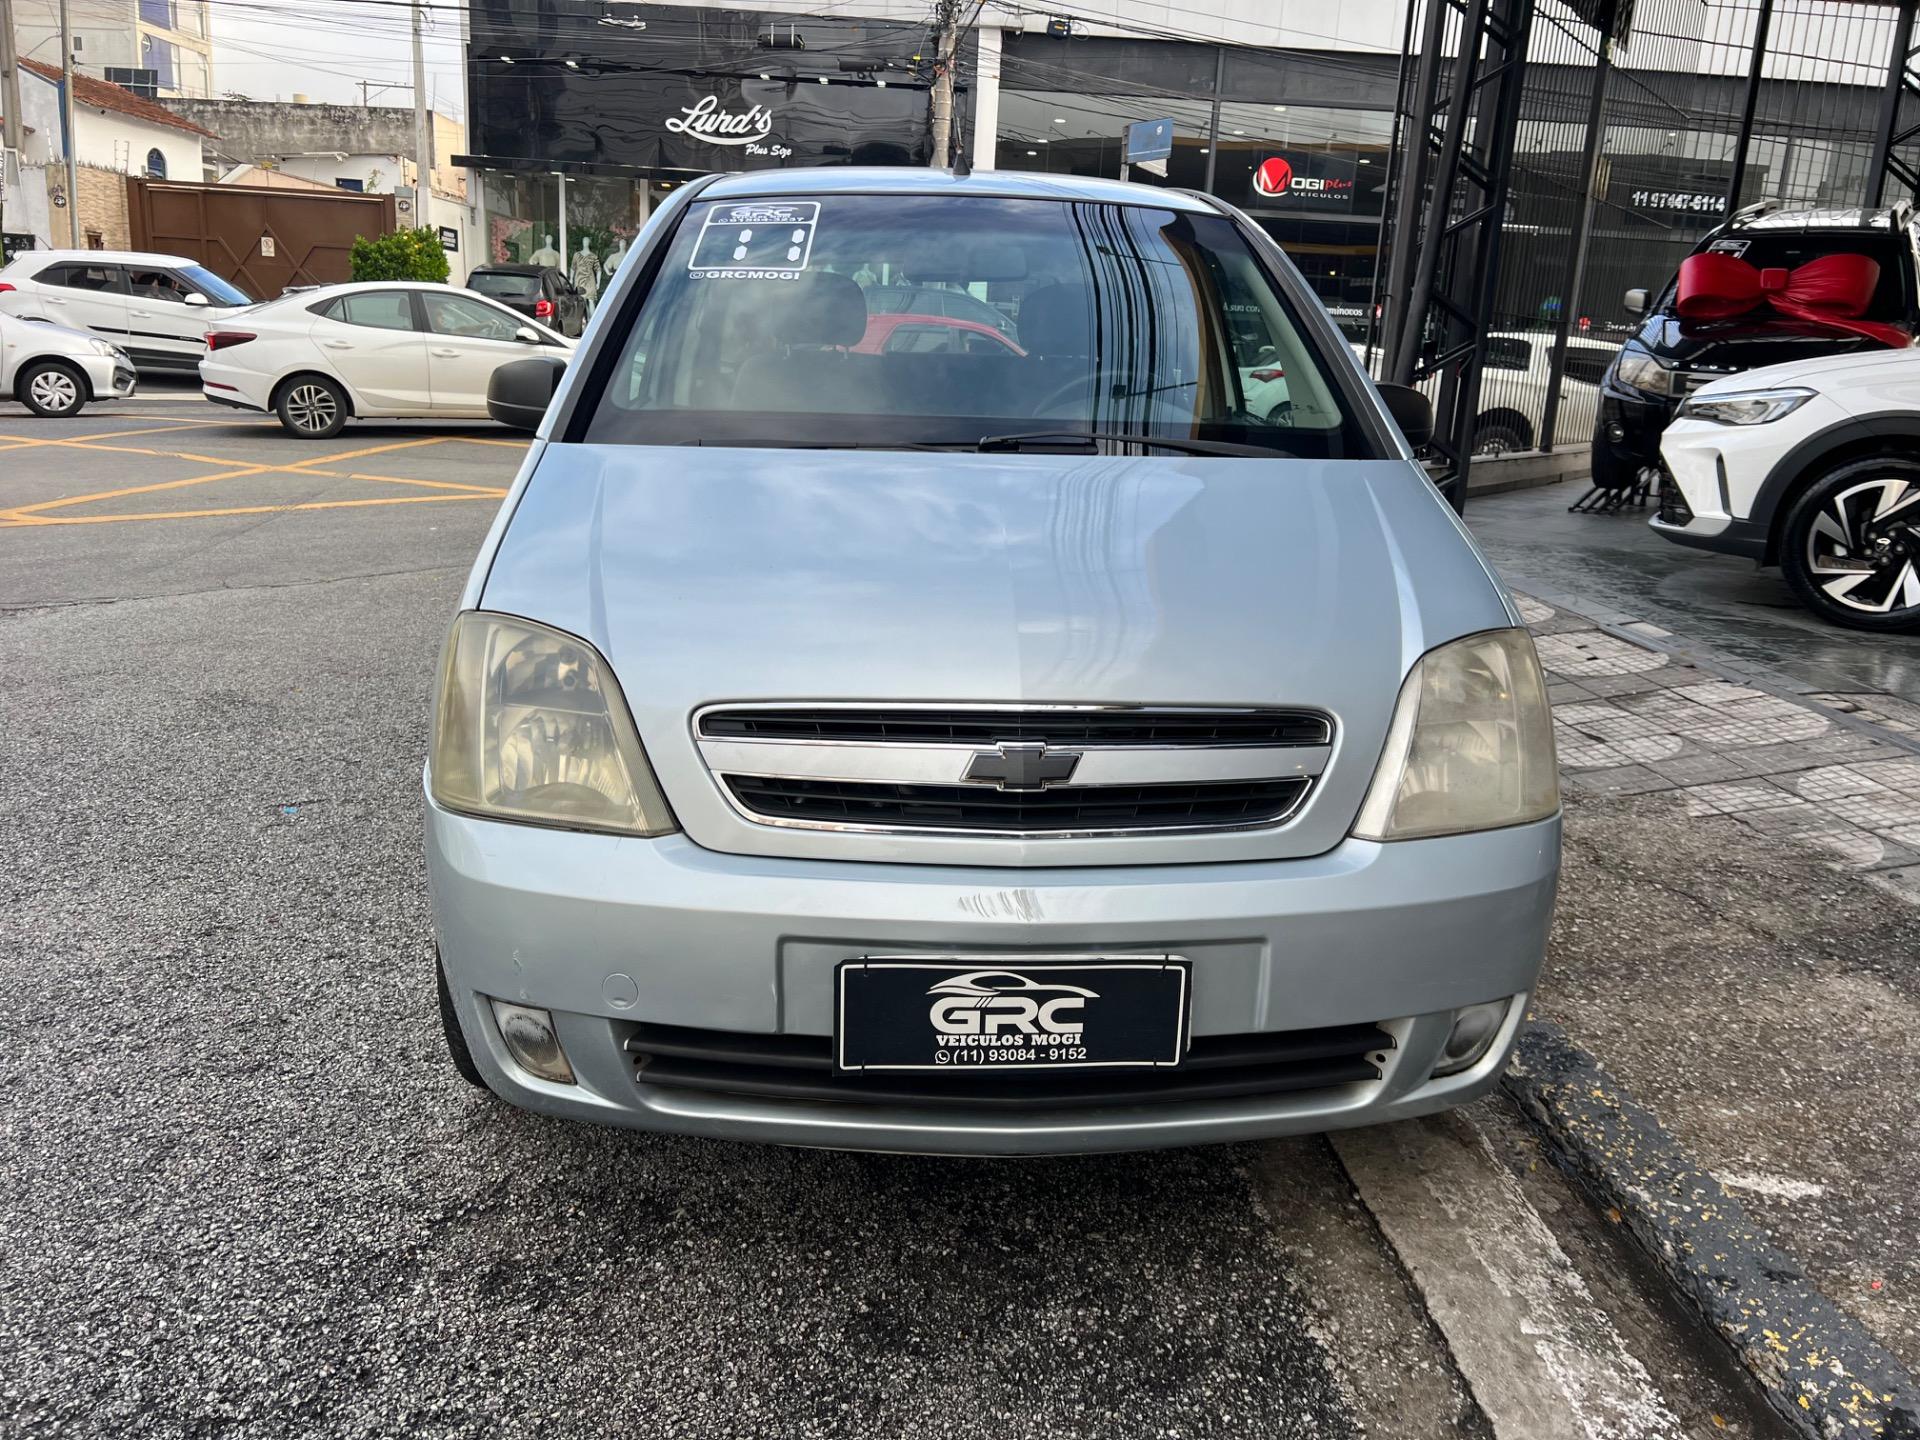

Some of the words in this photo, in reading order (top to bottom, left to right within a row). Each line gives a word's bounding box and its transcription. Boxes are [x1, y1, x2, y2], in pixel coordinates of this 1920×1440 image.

[665, 95, 772, 144] Lurd's
[745, 143, 768, 155] Plus
[770, 145, 792, 158] Size
[1293, 191, 1349, 200] VEICULOS
[1632, 191, 1649, 207] 11
[929, 996, 1085, 1034] GRC
[936, 1034, 1024, 1047] VEICULOS
[1031, 1033, 1082, 1046] MOGI
[953, 1049, 985, 1064] (11)
